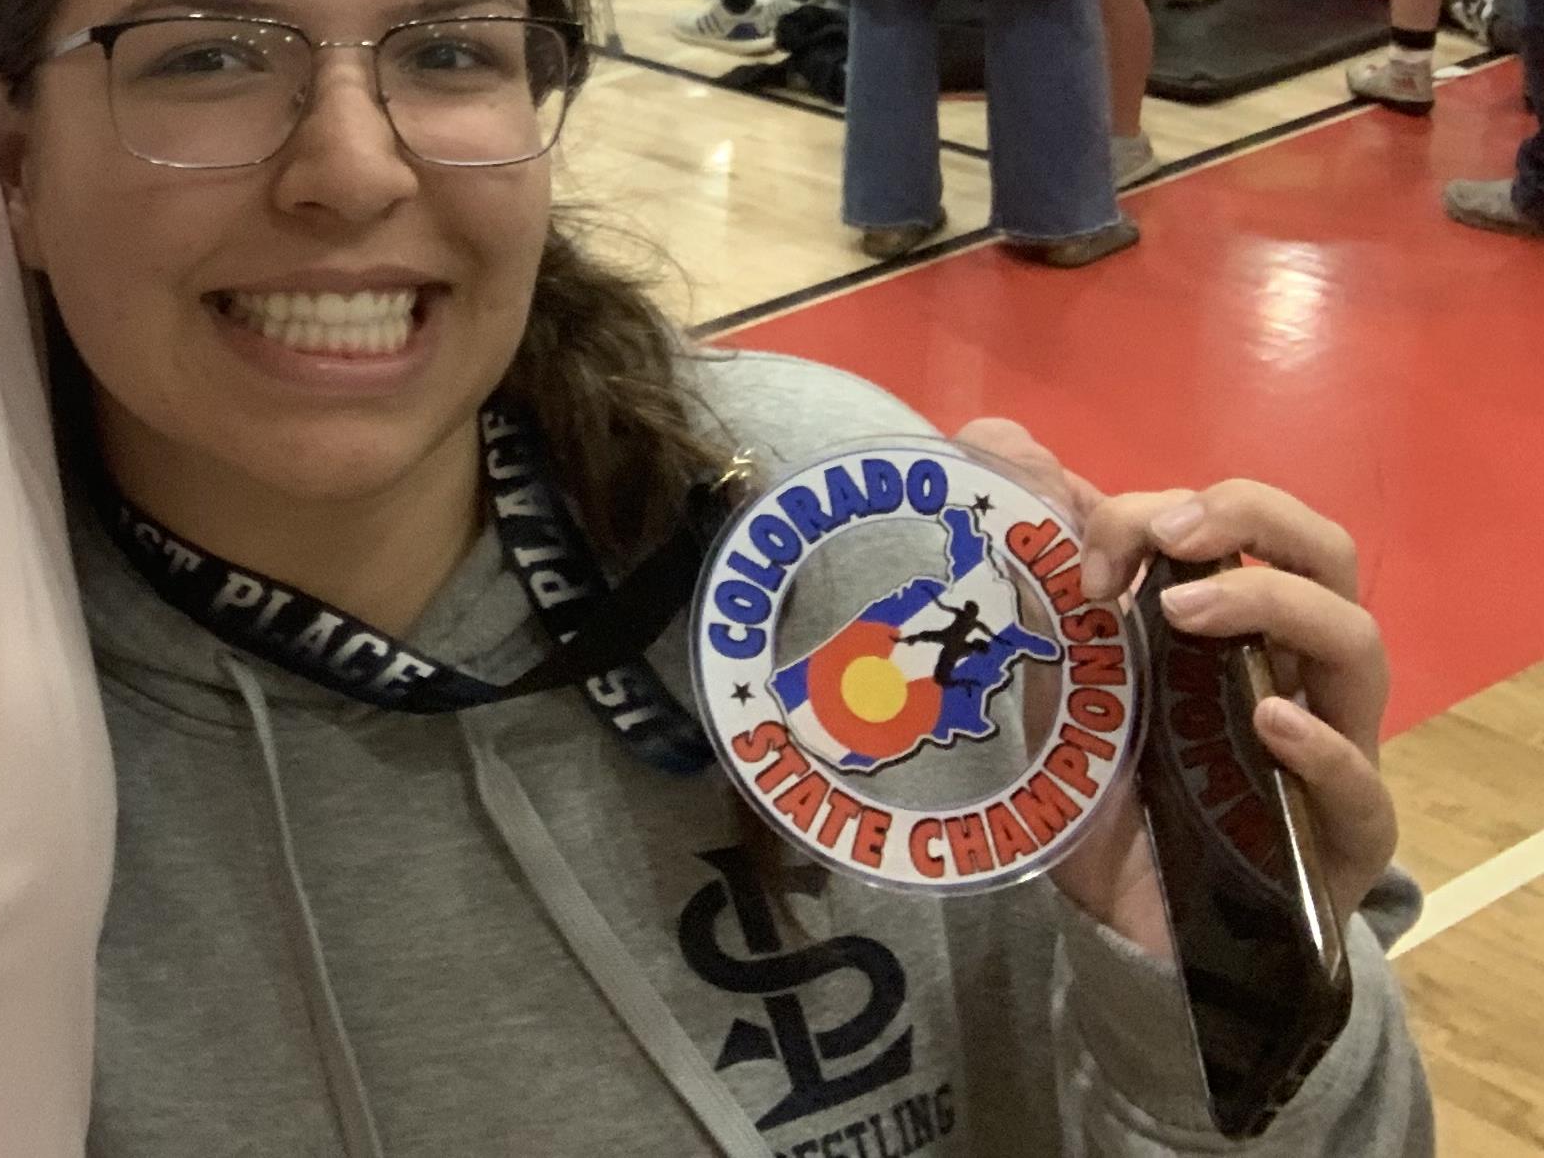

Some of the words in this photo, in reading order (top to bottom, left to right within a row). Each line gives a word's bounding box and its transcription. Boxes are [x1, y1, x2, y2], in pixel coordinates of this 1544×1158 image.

[210, 572, 436, 692] PLACE
[708, 458, 949, 660] COLORADO
[732, 721, 892, 869] STATE
[909, 517, 1128, 879] CHAMPIONSHIP
